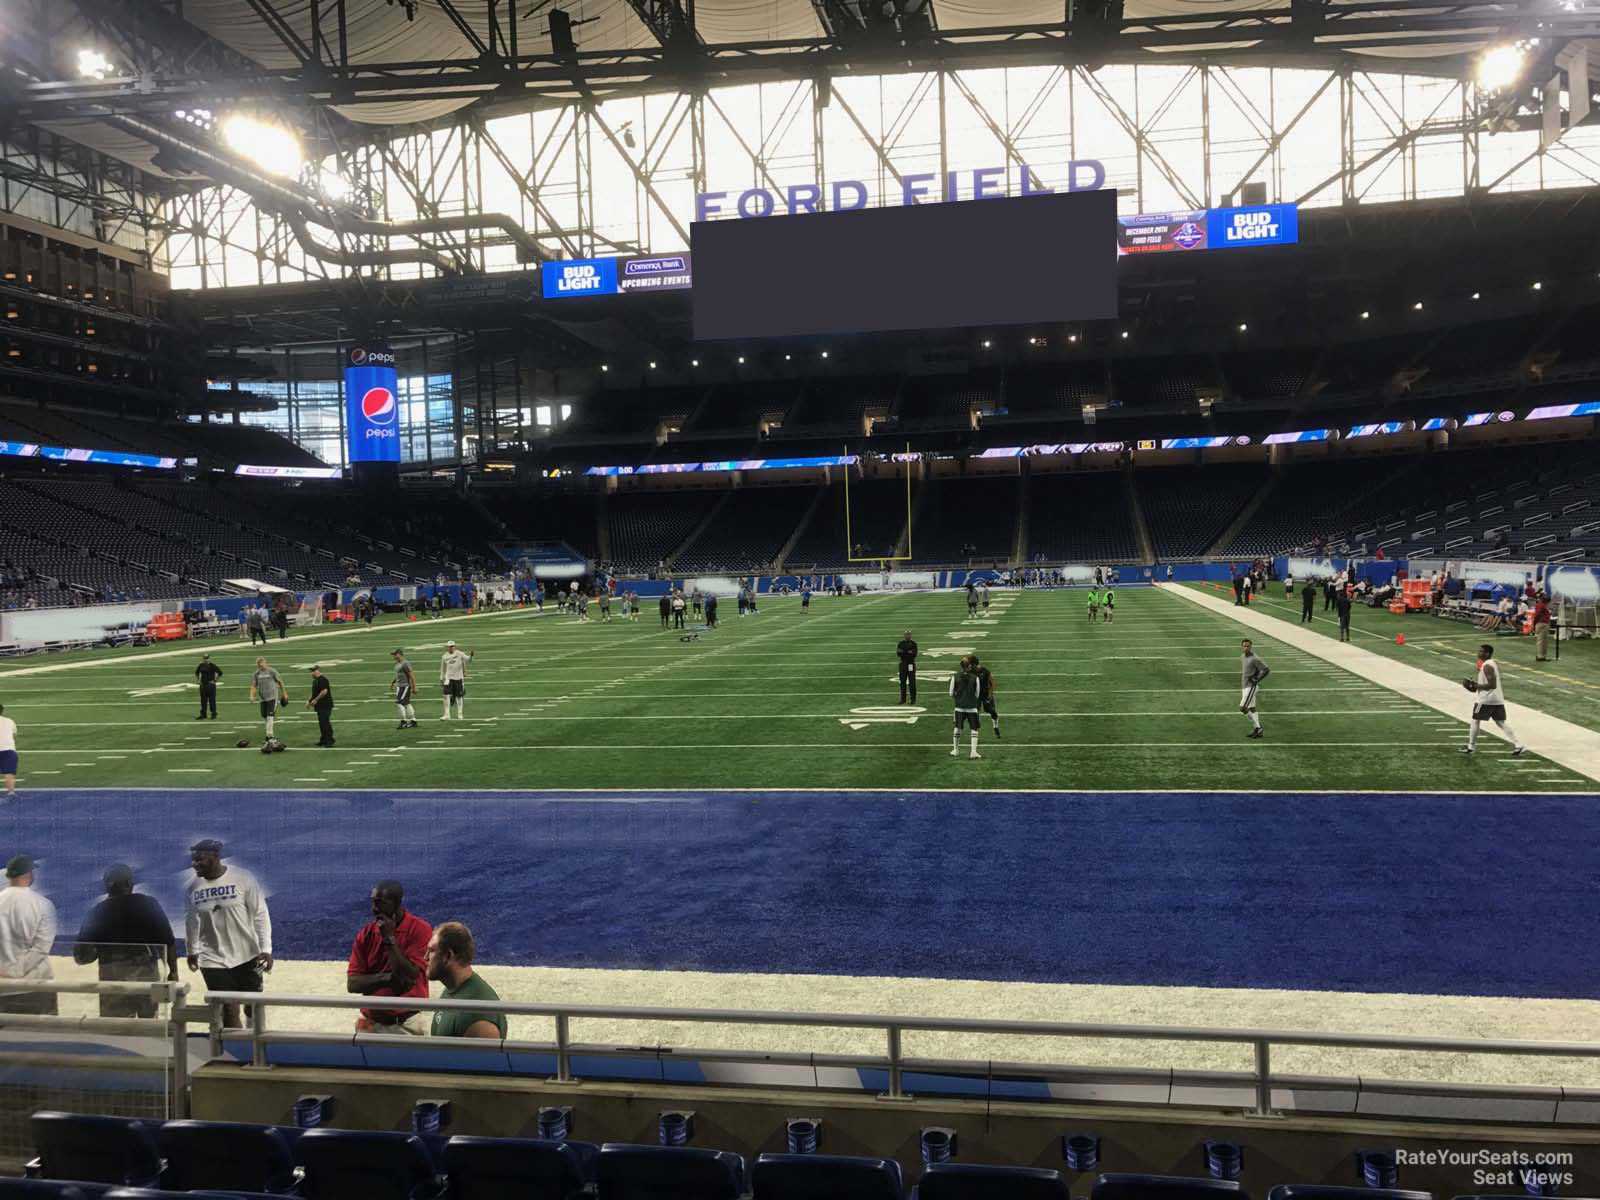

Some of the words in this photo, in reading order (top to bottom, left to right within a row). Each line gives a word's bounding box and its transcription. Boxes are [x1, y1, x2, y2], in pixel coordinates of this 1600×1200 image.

[696, 180, 868, 221] FORD
[901, 159, 1105, 206] FIELD
[1234, 212, 1272, 227] BUD
[1125, 227, 1154, 236] DECEMBER
[1227, 224, 1279, 240] LIGHT
[662, 259, 681, 269] Bank
[563, 265, 595, 279] BUD
[558, 276, 600, 291] LIGHT
[621, 277, 661, 289] UPCOMING
[663, 275, 691, 286] EVENTS
[368, 352, 395, 363] pepsi
[366, 428, 395, 439] pepsi
[194, 885, 237, 901] DETROIT
